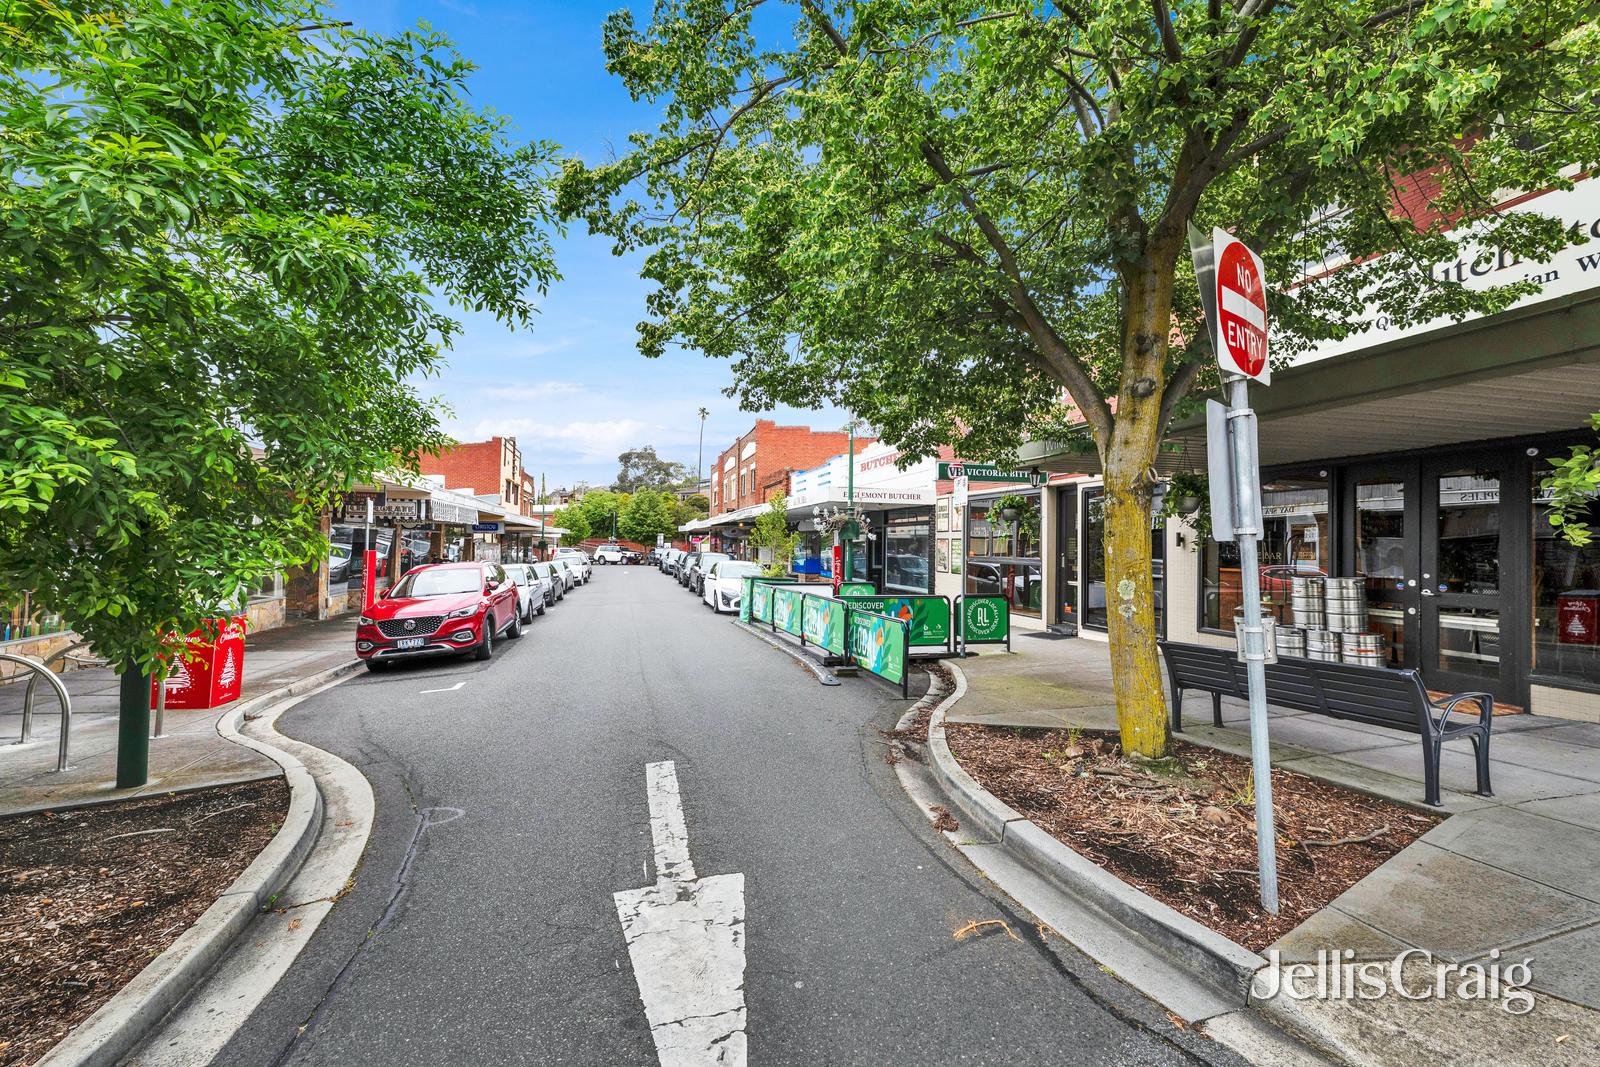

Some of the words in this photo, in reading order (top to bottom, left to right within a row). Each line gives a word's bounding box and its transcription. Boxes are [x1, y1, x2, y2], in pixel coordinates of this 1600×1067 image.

[1236, 262, 1252, 293] NO
[1227, 320, 1263, 359] ENTRY
[860, 451, 898, 472] BUTCHE
[949, 467, 962, 477] VB
[967, 468, 1007, 477] VICTORIA
[1010, 468, 1029, 478] BITT
[843, 491, 887, 499] EGLEMONT
